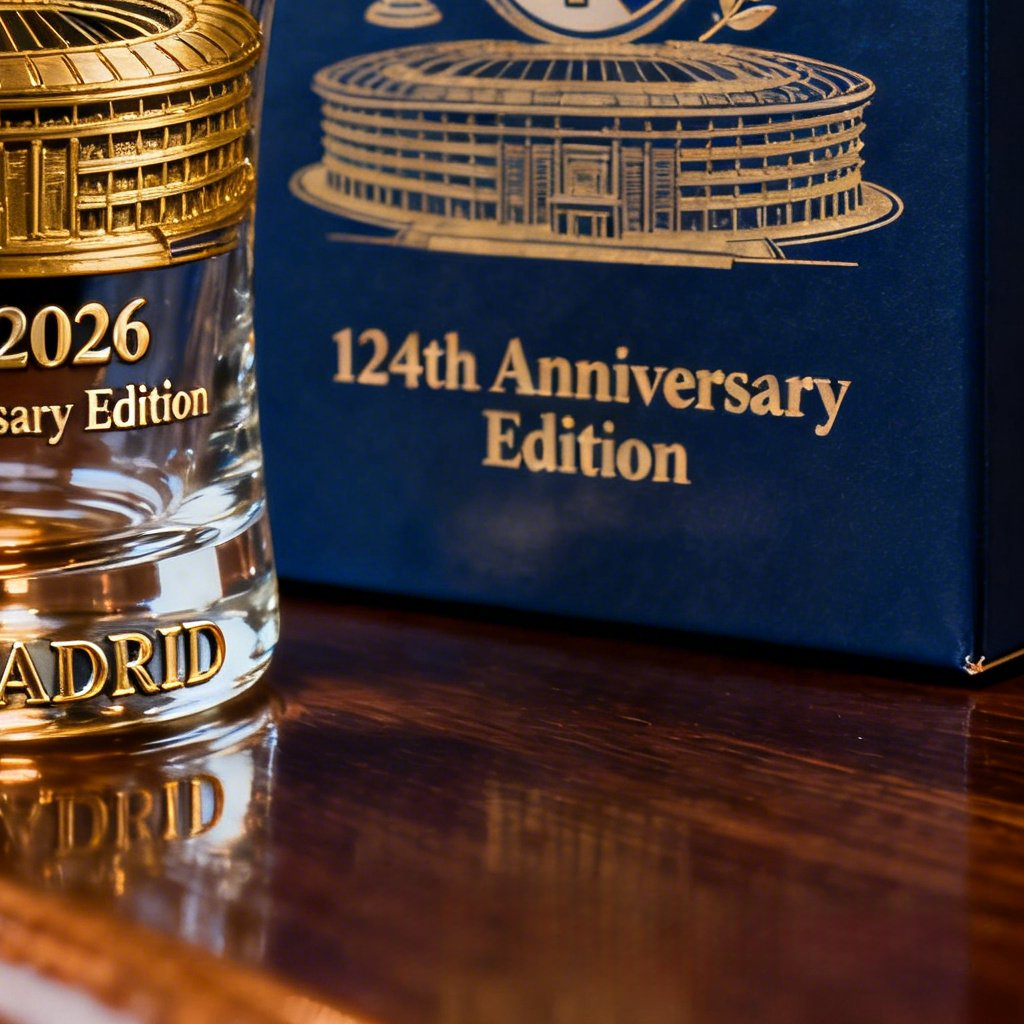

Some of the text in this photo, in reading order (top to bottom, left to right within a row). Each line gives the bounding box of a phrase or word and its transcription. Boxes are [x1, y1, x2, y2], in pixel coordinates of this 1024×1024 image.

[84, 378, 210, 432] Edition
[332, 327, 853, 437] 124th Anniversary
[482, 409, 692, 485] Edition
